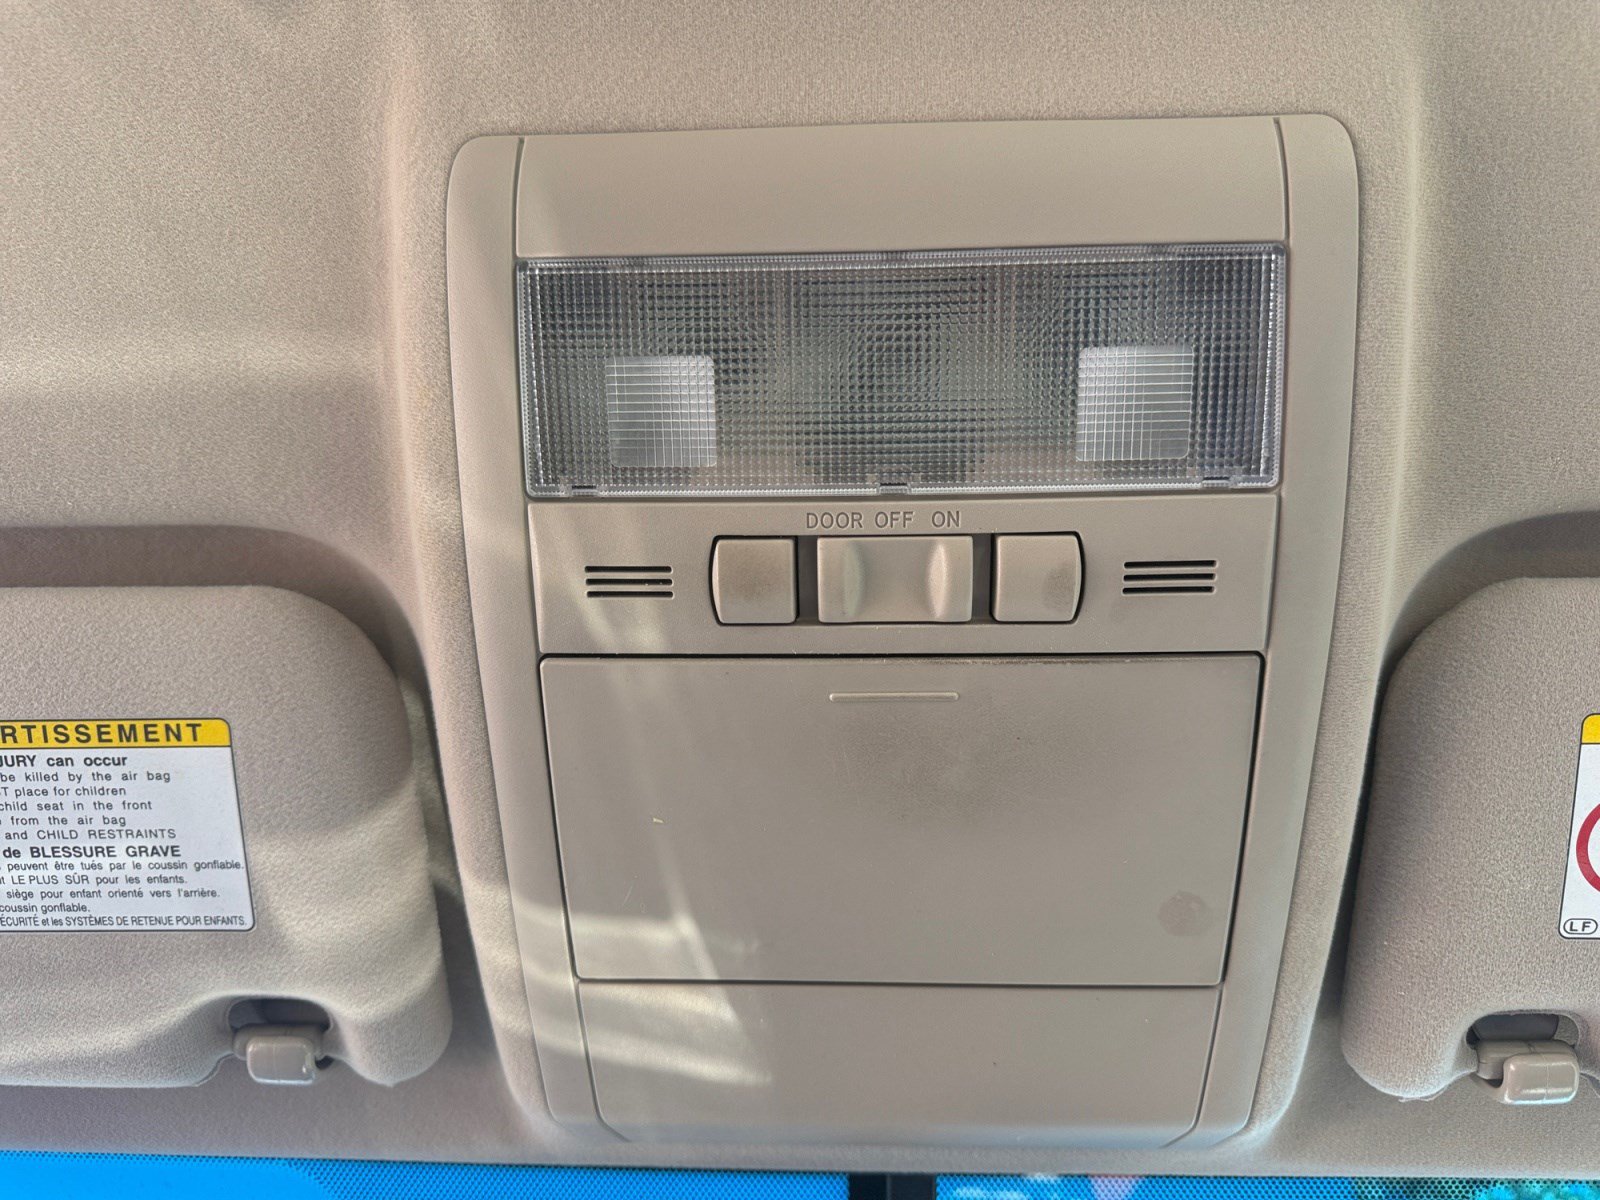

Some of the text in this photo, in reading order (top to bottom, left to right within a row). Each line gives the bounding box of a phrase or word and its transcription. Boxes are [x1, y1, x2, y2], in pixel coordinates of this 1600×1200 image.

[806, 510, 960, 529] DOOR OFF ON
[46, 757, 74, 767] can
[83, 757, 127, 767] occur
[0, 771, 170, 784] be killed by the air bag
[15, 787, 48, 799] place
[53, 786, 70, 796] for
[75, 786, 126, 796] children
[37, 802, 64, 811] seat
[73, 801, 84, 810] in
[93, 801, 113, 810] the
[122, 800, 152, 810] front
[11, 815, 126, 827] from the air bag
[5, 829, 176, 840] and CHILD RESTRAINTS
[3, 845, 181, 859] de BLESSURE GRAVE
[7, 862, 48, 873] peuvent
[54, 861, 74, 871] être
[80, 860, 103, 870] tués
[109, 863, 126, 872] par
[132, 861, 142, 870] le
[148, 860, 187, 870] coussin
[11, 875, 26, 885] LE
[29, 875, 59, 885] PLUS
[65, 872, 89, 884] SÛR
[96, 877, 119, 886] pour
[125, 875, 140, 884] les
[147, 874, 187, 884] enfants.
[6, 889, 34, 901] siège
[40, 891, 64, 901] pour
[70, 889, 102, 898] enfant
[108, 887, 143, 898] orienté
[150, 890, 172, 898] vers
[0, 903, 38, 913] coussin
[41, 917, 50, 926] et
[51, 917, 63, 926] les
[65, 914, 114, 926] SYSTÈMES
[116, 916, 129, 926] DE
[131, 916, 175, 926] RETENUE
[176, 916, 202, 925] POUR
